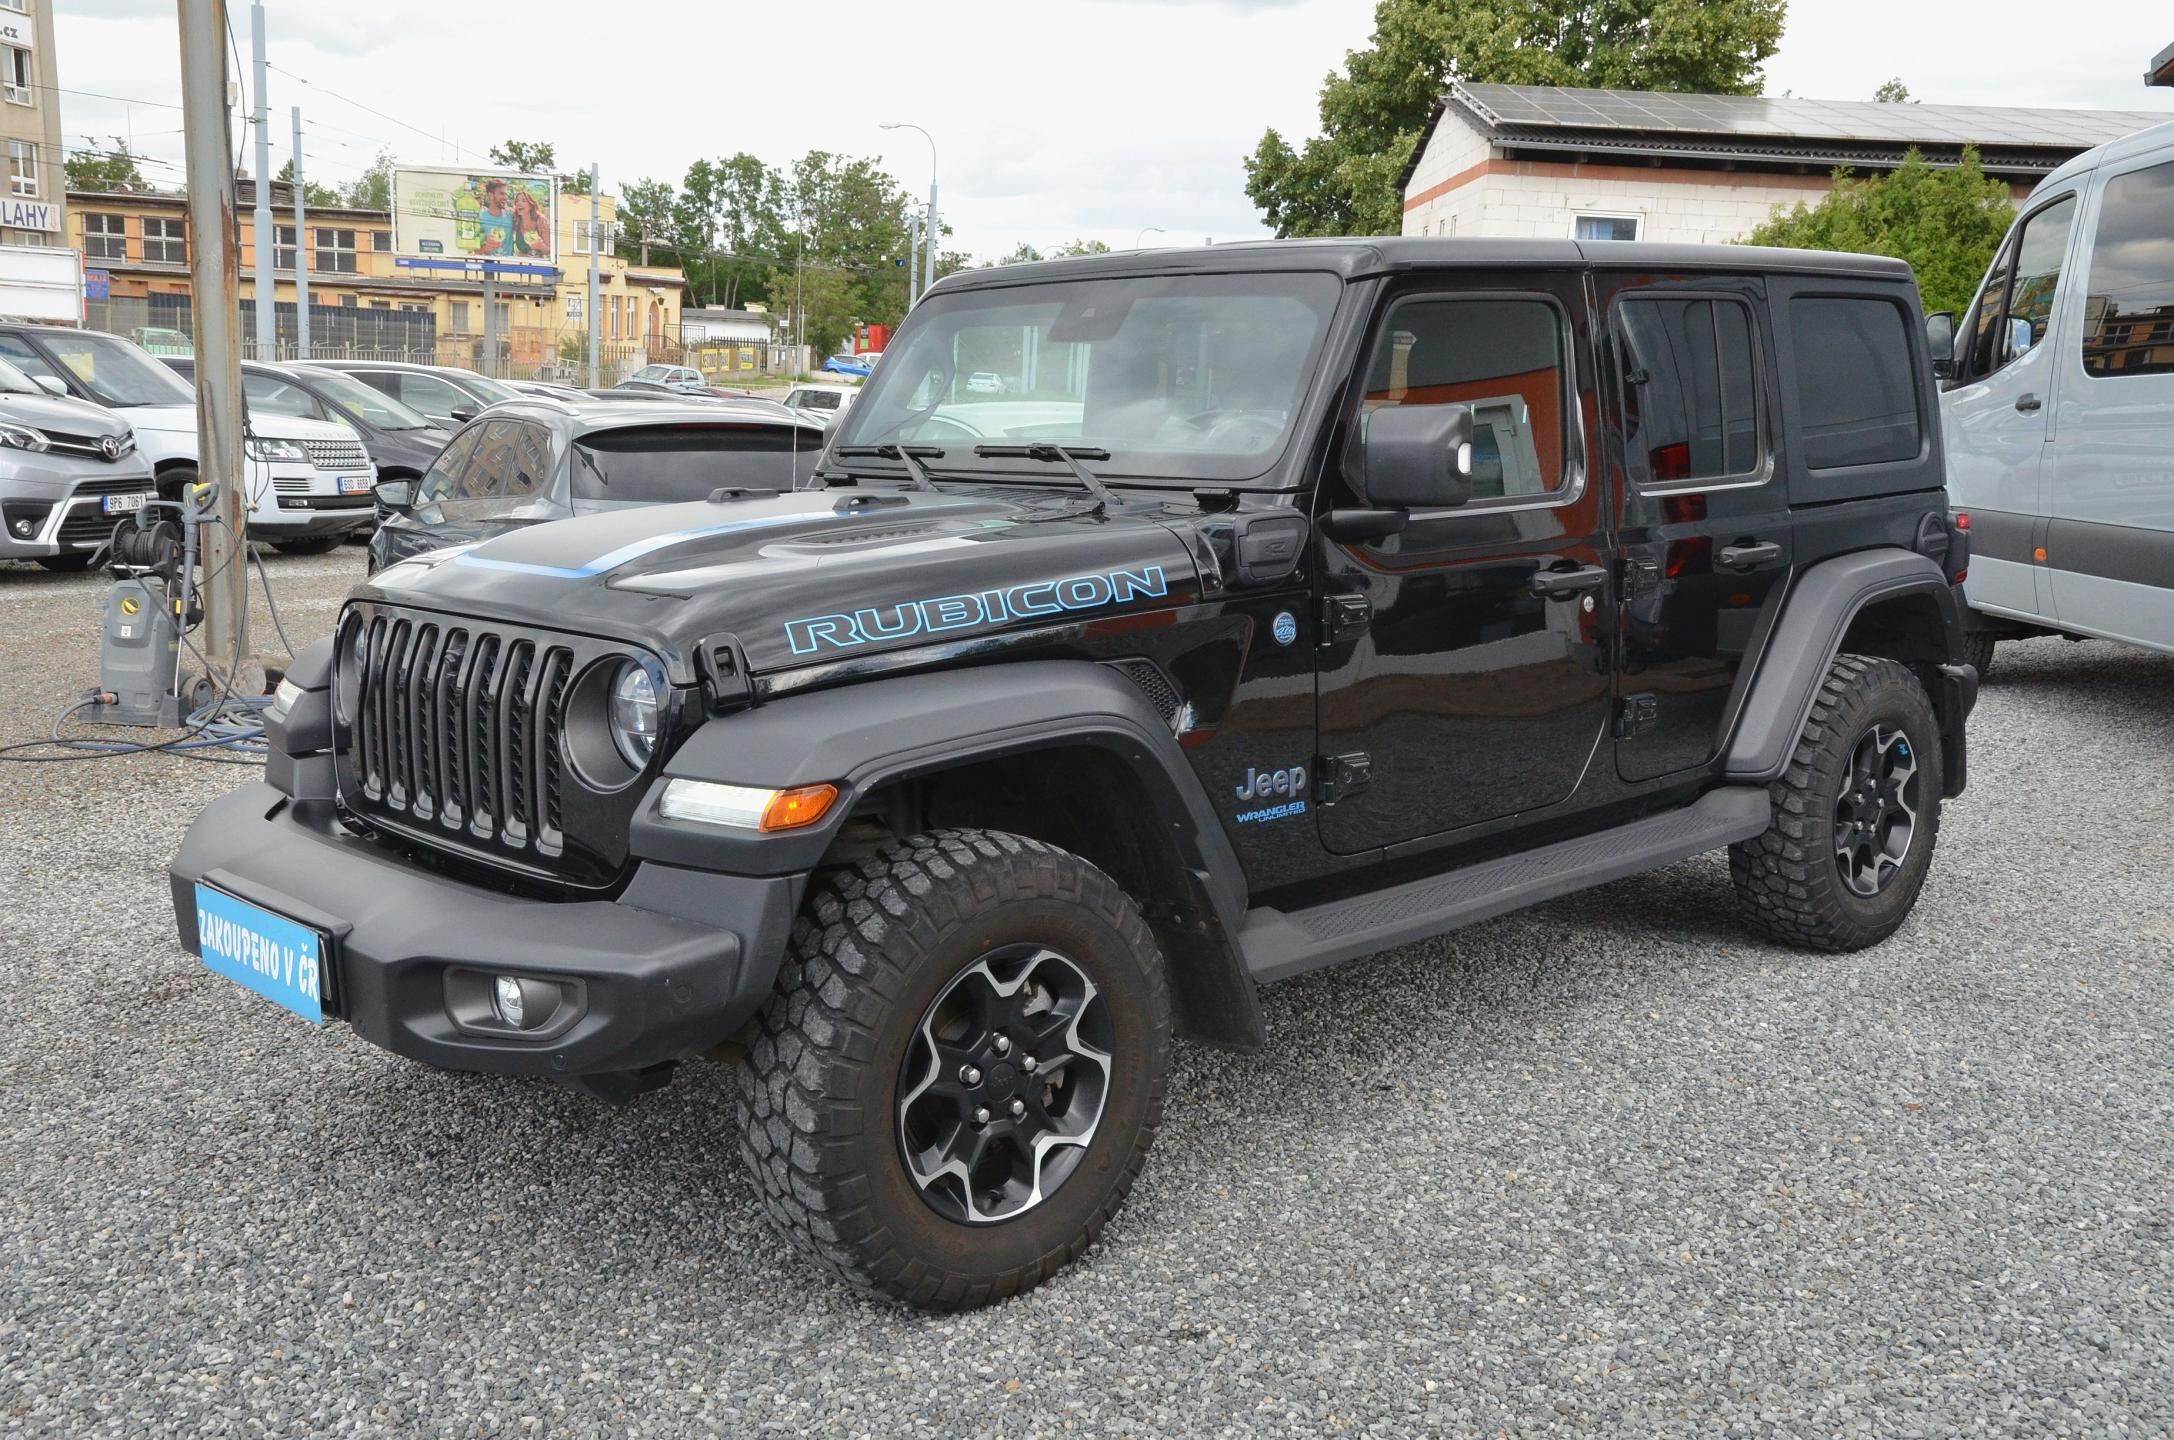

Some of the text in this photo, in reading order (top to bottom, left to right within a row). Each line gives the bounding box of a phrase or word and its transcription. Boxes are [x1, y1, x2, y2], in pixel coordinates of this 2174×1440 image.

[2, 201, 48, 228] LAHY
[783, 565, 1167, 655] RUBICON
[1236, 766, 1306, 800] Jeep
[1236, 801, 1305, 823] WRANGLER
[1258, 808, 1305, 822] UNLIMITED
[199, 909, 318, 1003] ZAKOUPENO V ČR
